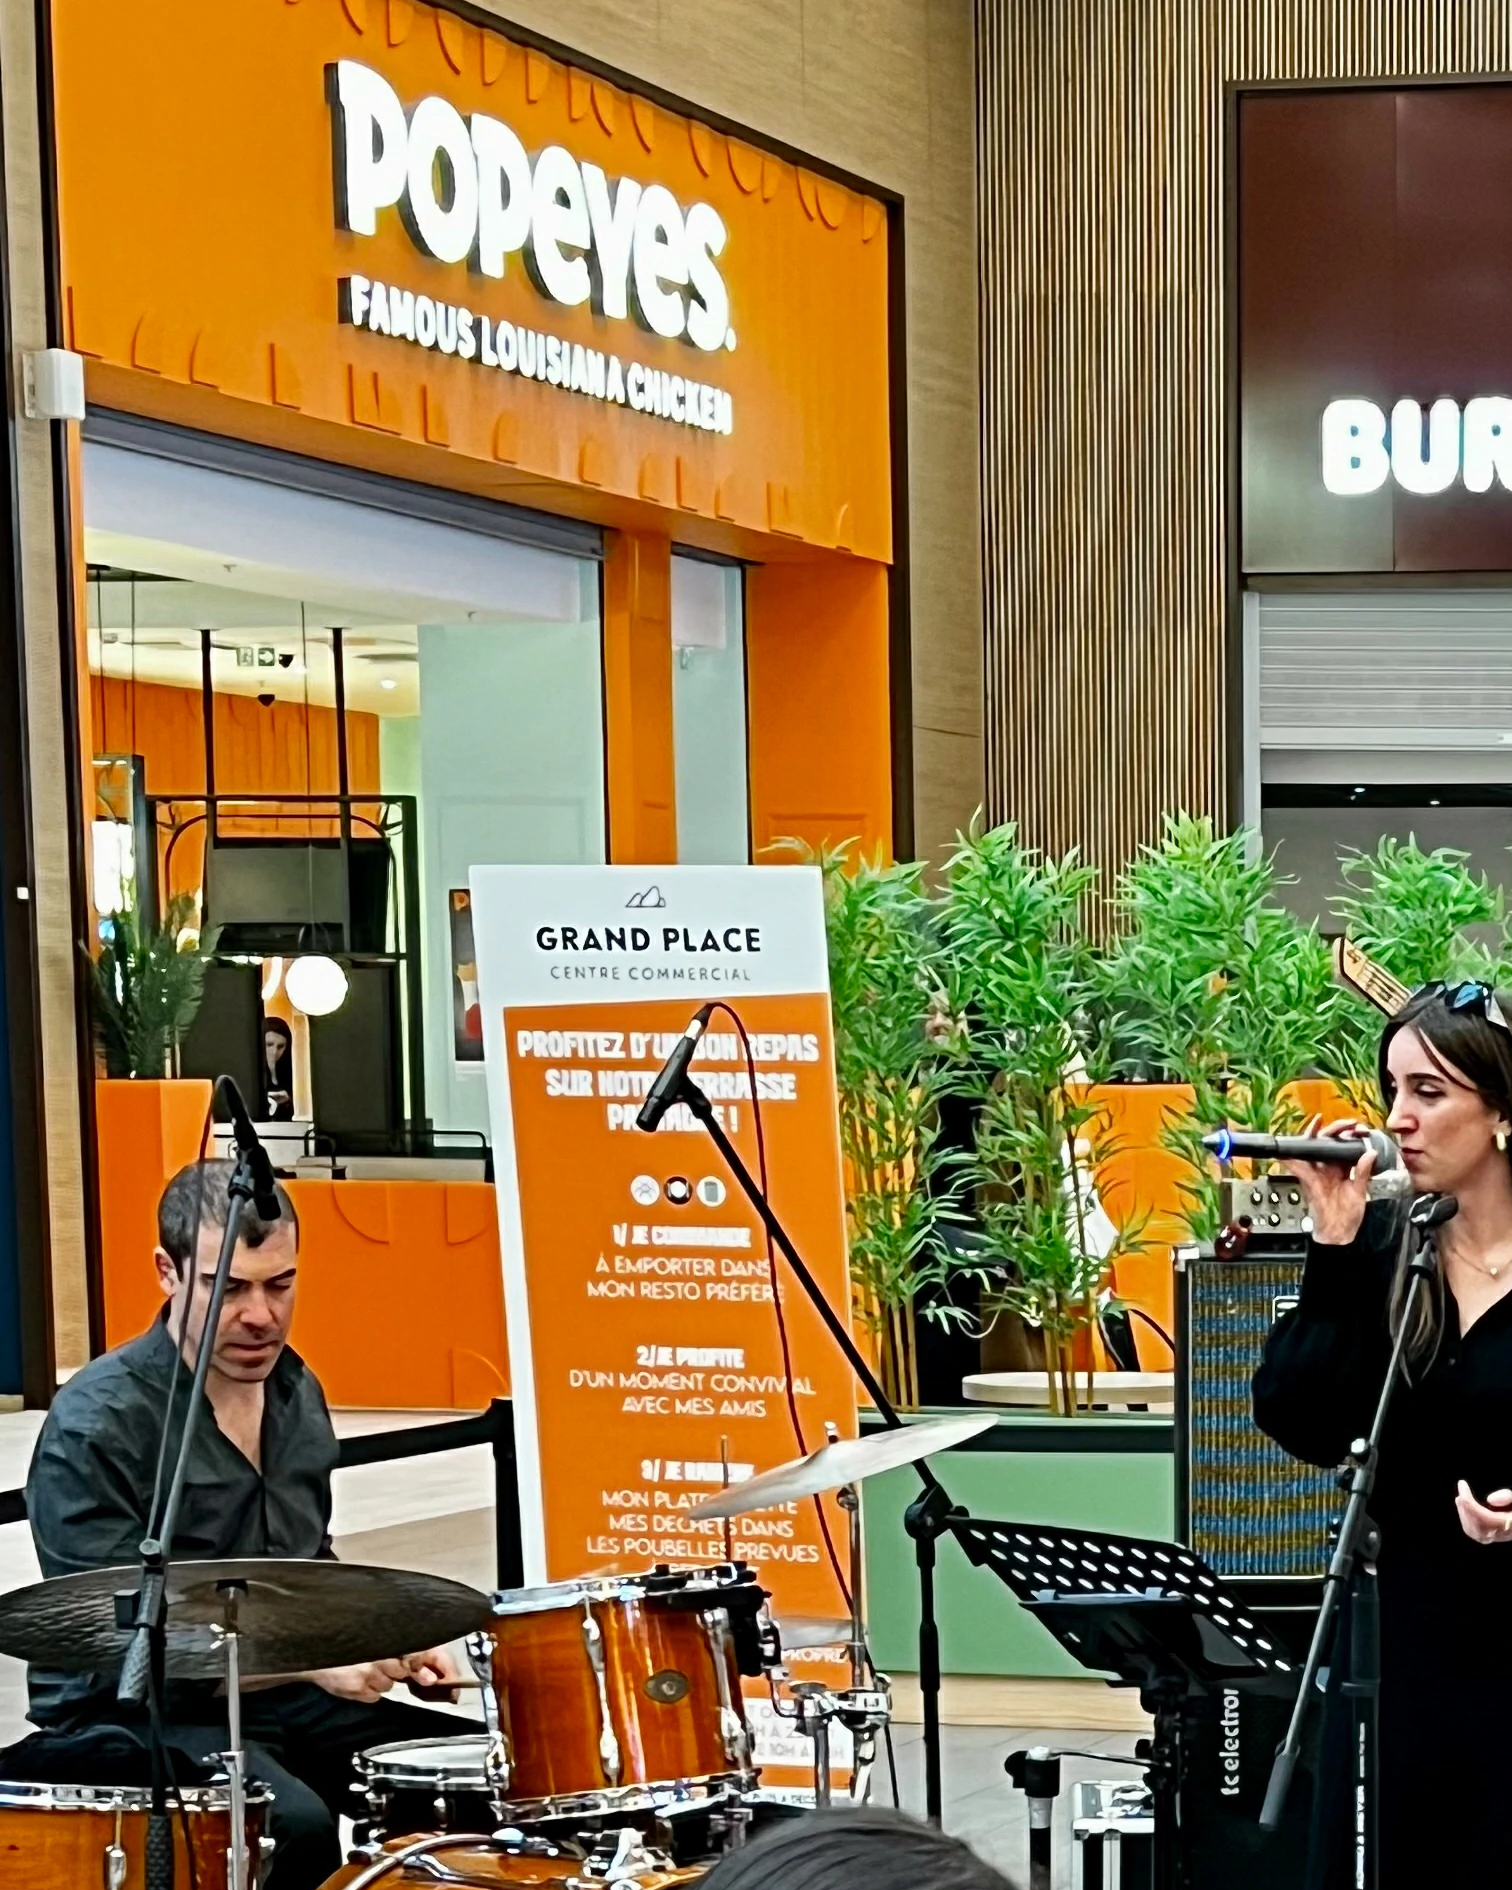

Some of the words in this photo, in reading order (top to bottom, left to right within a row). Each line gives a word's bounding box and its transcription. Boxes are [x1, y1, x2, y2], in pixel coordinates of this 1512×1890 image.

[350, 273, 475, 361] FAMOUS
[480, 315, 626, 405] LOUISIANA
[626, 360, 733, 436] CHICKEN
[536, 926, 650, 953] GRAND
[663, 927, 762, 953] PLACE
[550, 965, 621, 981] CENTRE
[628, 967, 752, 982] COMMERCIAL
[517, 1031, 625, 1059] PROFITEZ
[741, 1033, 820, 1062] REPAS
[545, 1070, 593, 1097] SUR
[729, 1105, 738, 1133] !
[614, 1255, 717, 1277] EMPORTER
[721, 1258, 771, 1279] DANS
[587, 1280, 635, 1298] MON
[640, 1281, 701, 1301] RESTO
[569, 1370, 614, 1388] D'UN
[619, 1371, 705, 1391] MOMENT
[710, 1374, 817, 1395] CONVIVAL
[621, 1396, 670, 1414] AVEC
[675, 1397, 714, 1415] MES
[720, 1399, 767, 1418] AMIS
[602, 1490, 649, 1508] MON
[609, 1514, 648, 1533] MES
[742, 1518, 795, 1538] DANS
[586, 1536, 619, 1554] LES
[624, 1537, 727, 1560] POUBELLES
